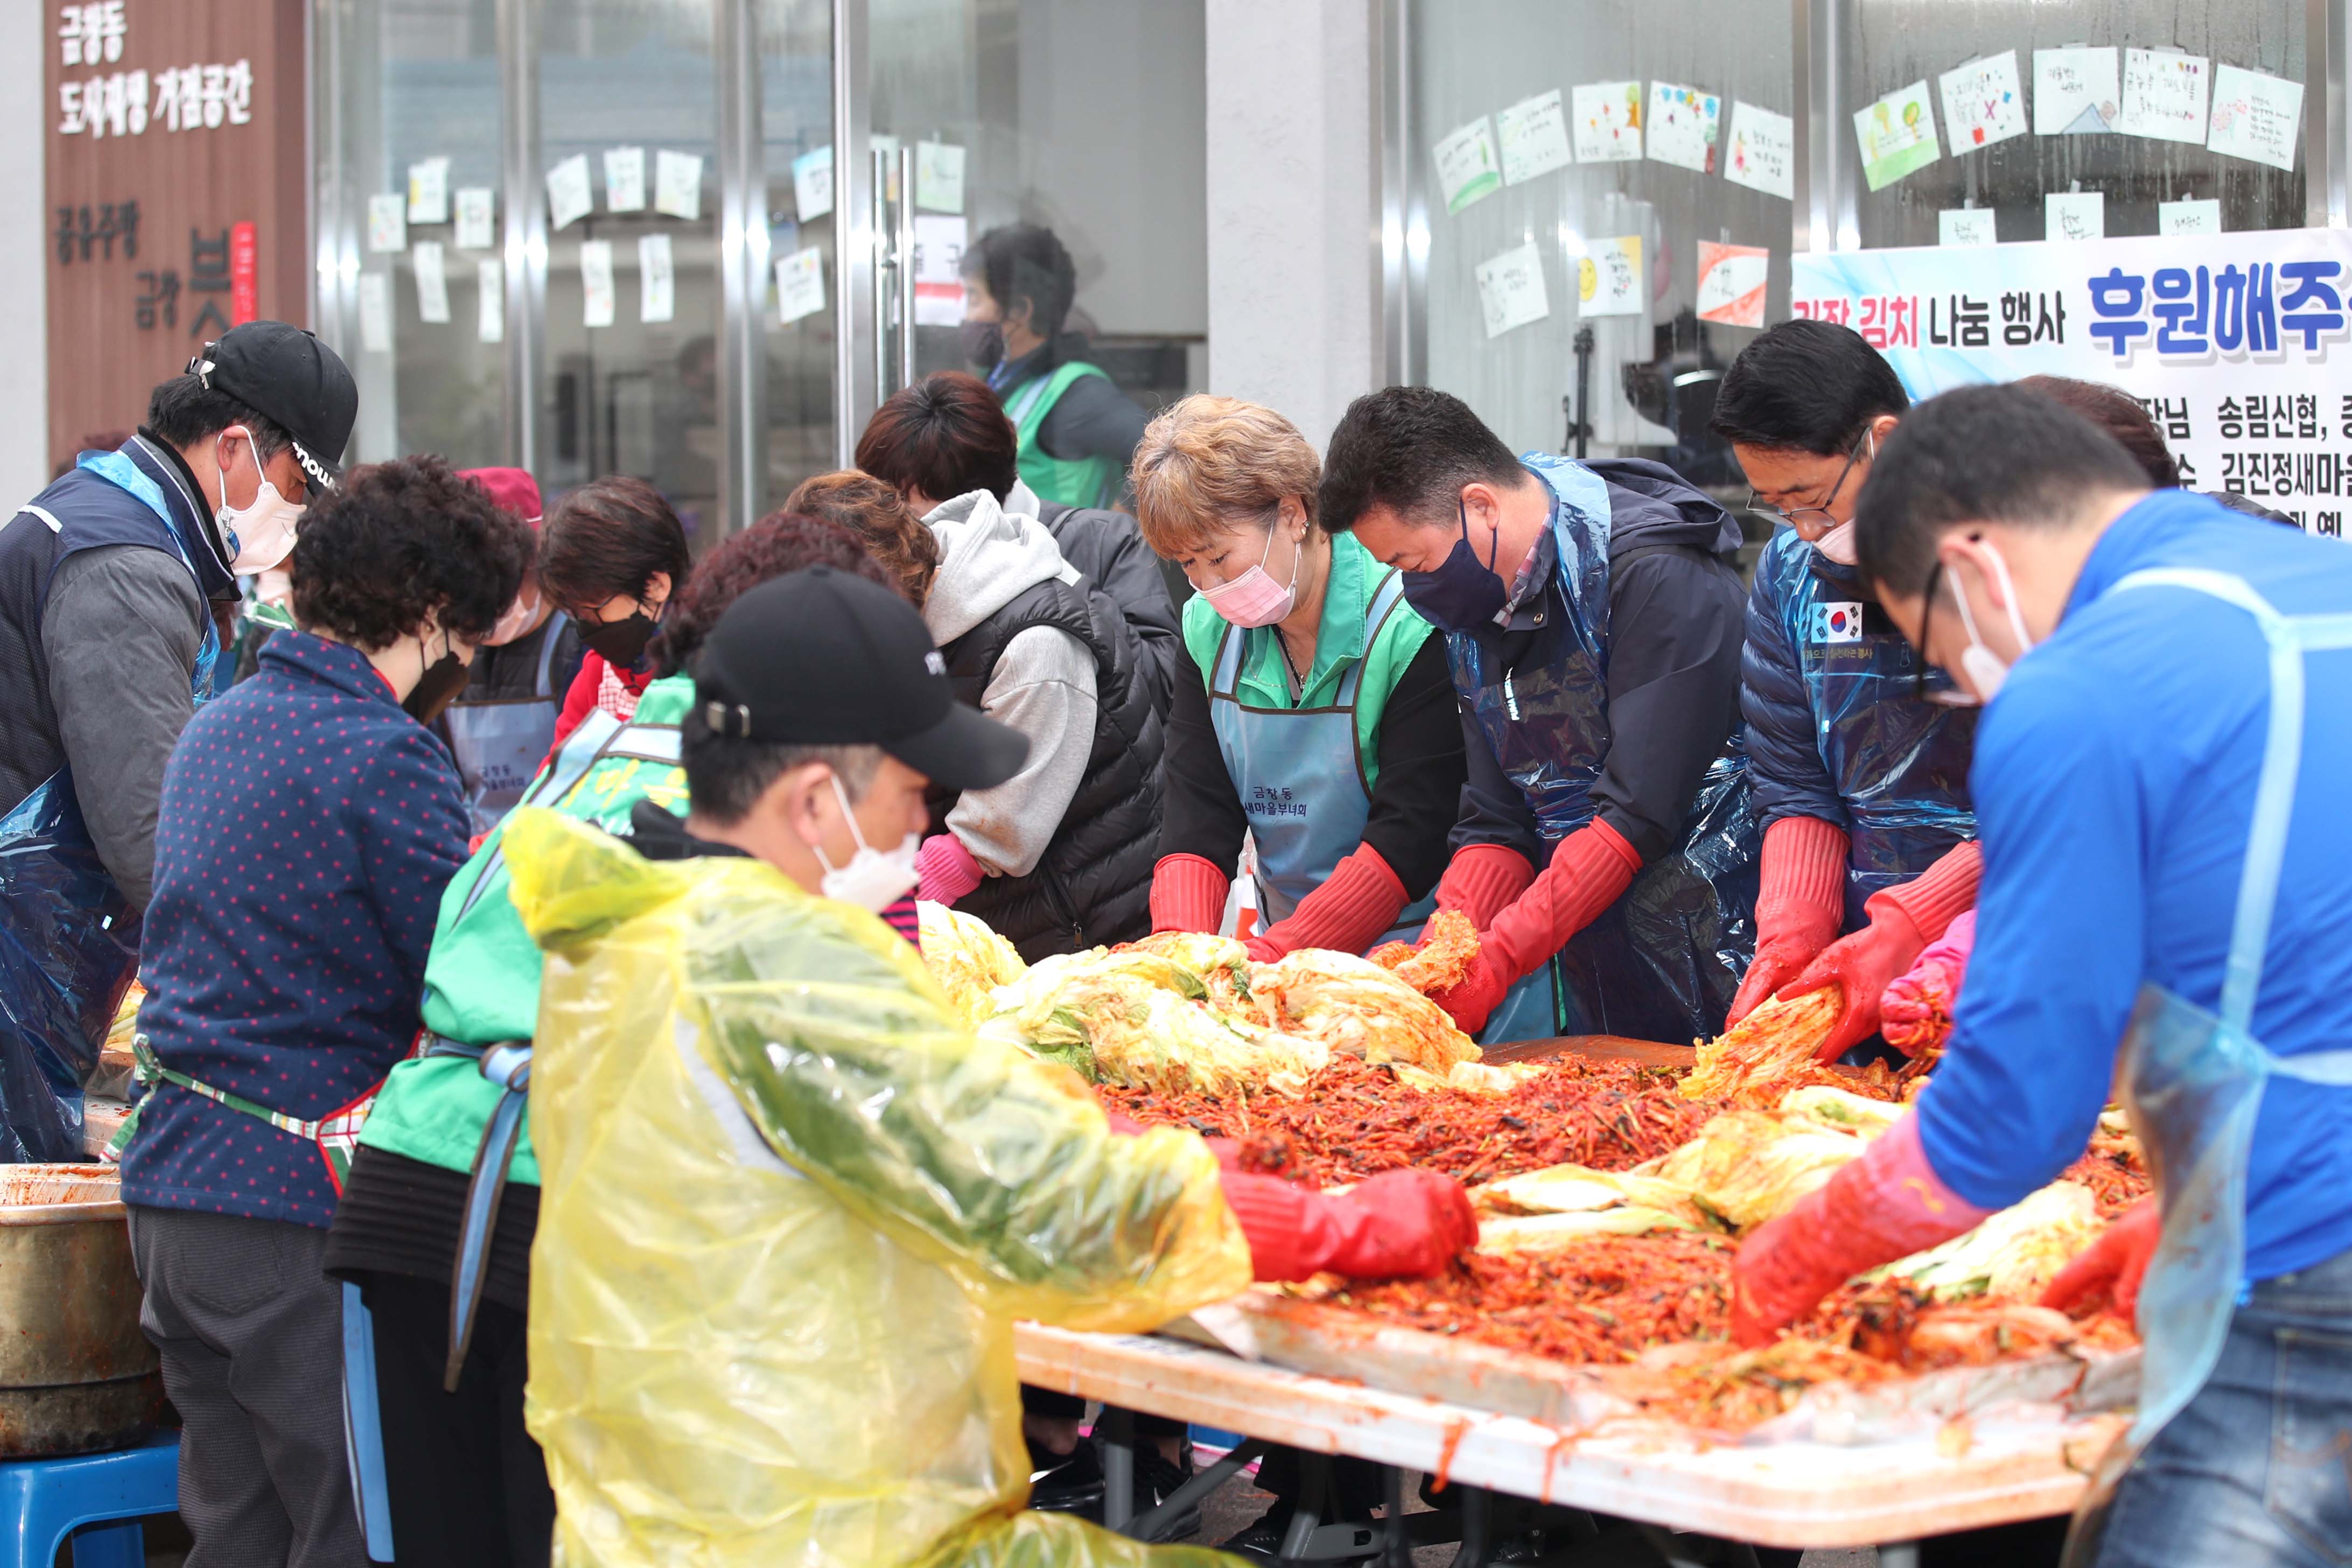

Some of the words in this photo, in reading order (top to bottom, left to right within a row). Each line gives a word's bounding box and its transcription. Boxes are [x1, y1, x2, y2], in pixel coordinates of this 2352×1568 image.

[1859, 295, 1918, 349] 김치
[1930, 293, 1990, 347] 나눔
[2000, 290, 2066, 346] 행사
[2088, 261, 2352, 356] 후원해주
[2217, 394, 2327, 441] 송림신협,
[1253, 786, 1292, 800] 금창동
[1244, 802, 1307, 817] 새마을부녀회
